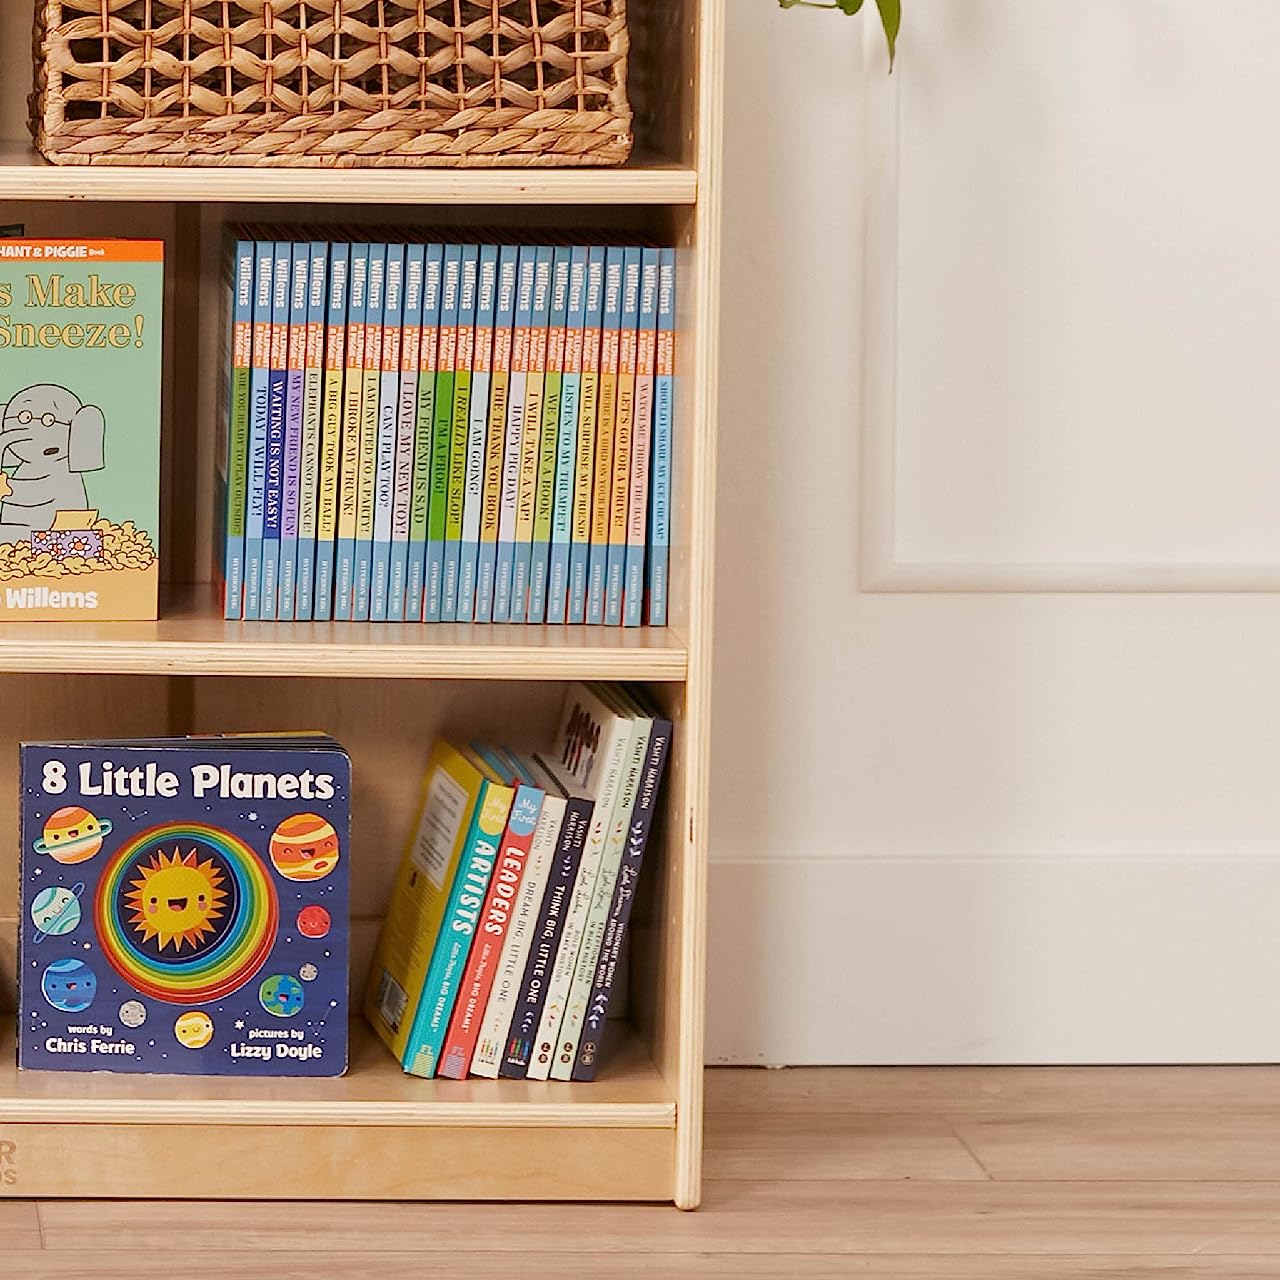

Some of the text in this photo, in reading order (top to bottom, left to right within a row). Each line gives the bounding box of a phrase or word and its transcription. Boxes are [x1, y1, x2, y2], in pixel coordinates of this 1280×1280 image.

[33, 246, 42, 257] &
[44, 245, 88, 258] PIGGIE
[24, 273, 136, 308] Make
[258, 257, 272, 307] Willems
[255, 386, 267, 436] TODAY
[267, 258, 288, 529] Willems WAITING IS NOT EASY!
[322, 260, 345, 533] Willems A BIG GUY TOOK MY BALL!
[414, 261, 439, 524] Willems MY FRIEND IS SAD
[485, 262, 514, 530] Willems THE THANK YOU BOOK
[614, 264, 639, 527] Willems LET'S GO FOR A DRIVE!
[253, 446, 265, 482] WILL
[252, 487, 263, 516] FLY!
[5, 587, 98, 609] Willems
[41, 760, 335, 800] 8 Little Planets
[622, 736, 646, 809] VASHTI HARRISON
[640, 736, 666, 810] VASHTI HARRISON
[562, 811, 579, 852] HARRISON
[572, 820, 588, 848] VASHTI
[452, 839, 496, 935] ARTISTS
[484, 847, 525, 936] LEADERS
[498, 881, 536, 1003] DREAM BIG, LITTLE ONE
[526, 885, 565, 1004] THINK BIG, LITTLE ONE
[45, 1037, 135, 1055] Chris Ferrie
[67, 1024, 113, 1037] words by
[230, 1042, 323, 1061] Lizzy Doyle
[248, 1027, 304, 1042] pictures by
